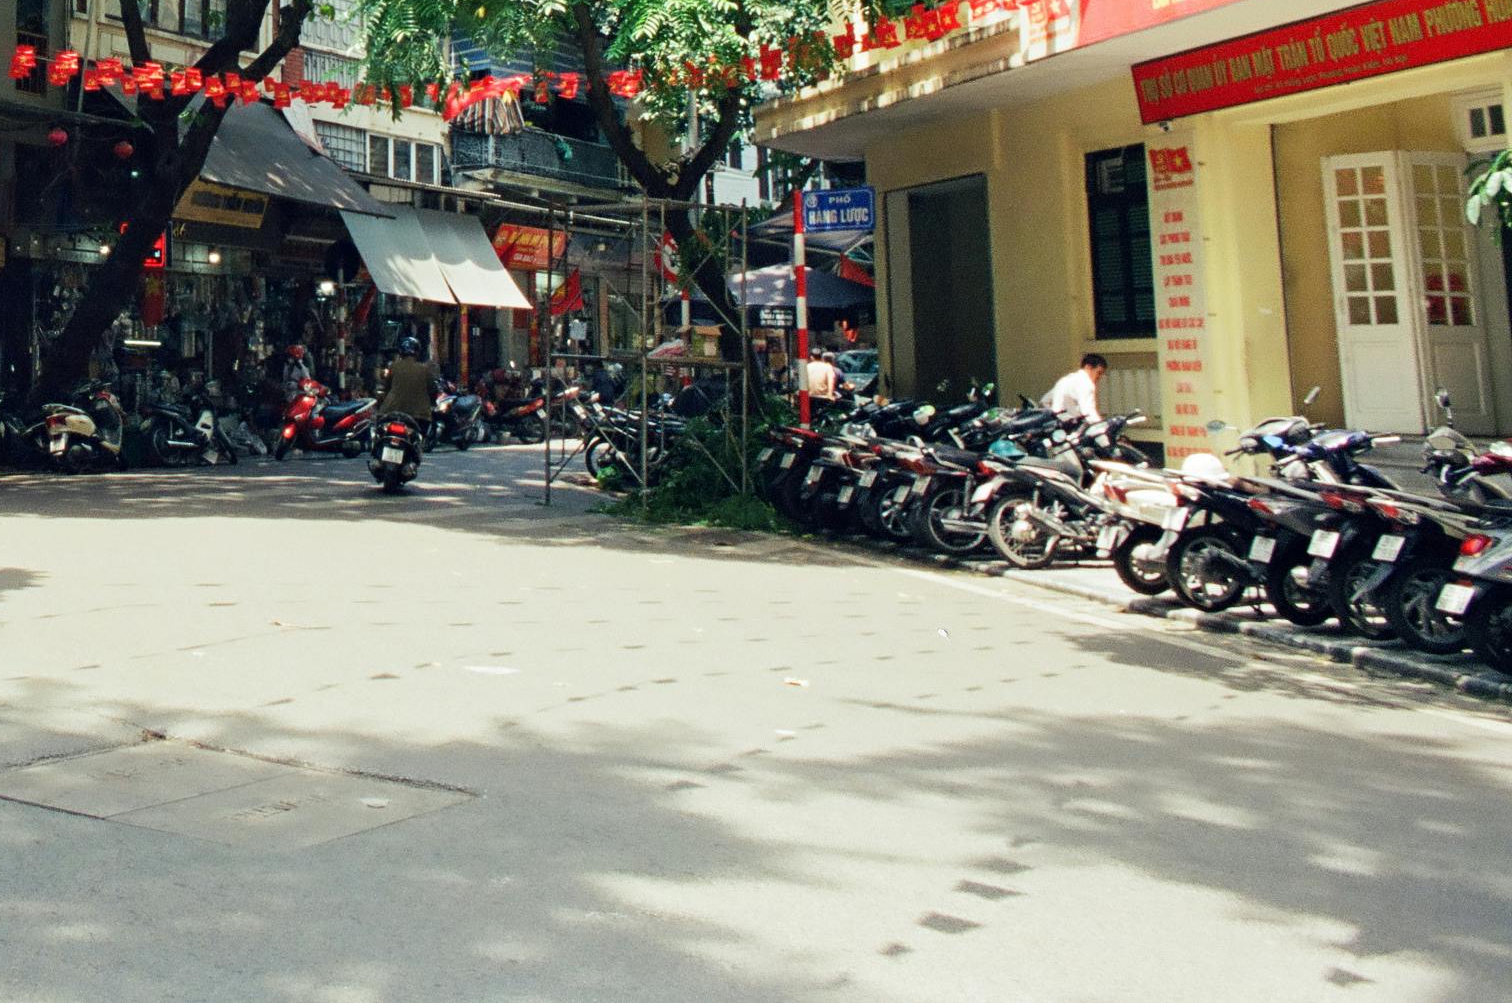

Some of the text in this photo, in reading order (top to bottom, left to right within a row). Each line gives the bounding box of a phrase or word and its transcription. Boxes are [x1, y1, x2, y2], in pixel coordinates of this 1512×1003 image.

[1276, 38, 1308, 74] TRẬN
[1308, 25, 1326, 64] TỔ
[1326, 21, 1359, 62] QUỐC
[1361, 18, 1387, 55] VIỆT
[1389, 12, 1424, 46] NAM
[828, 193, 851, 204] PHỐ
[840, 206, 868, 226] LƯỢC
